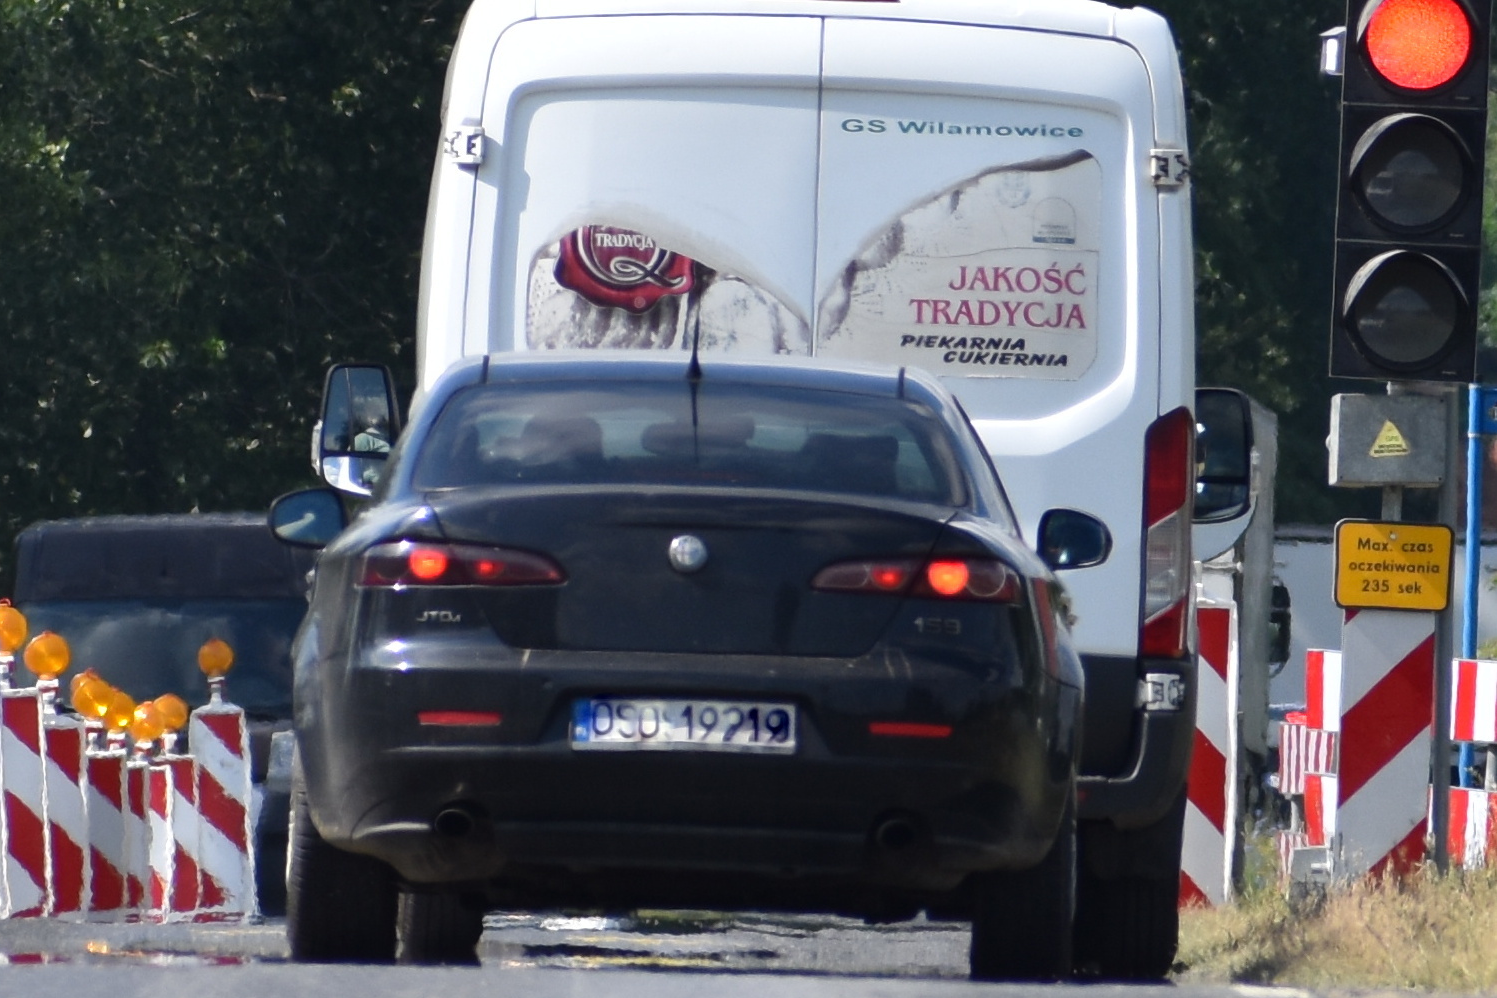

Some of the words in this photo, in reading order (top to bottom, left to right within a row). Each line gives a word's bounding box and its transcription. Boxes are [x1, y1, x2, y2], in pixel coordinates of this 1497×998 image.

[841, 118, 887, 134] GS
[897, 120, 1084, 138] Wilamowice
[595, 233, 654, 250] TRADYCJA
[949, 261, 1086, 295] JAKOŚĆ
[909, 298, 1087, 330] TRADYCJA
[900, 334, 1026, 351] PIEKARNIA
[943, 350, 1069, 367] CUKIERNIA
[1357, 537, 1393, 552] Max.
[1401, 541, 1434, 554] czas
[1348, 559, 1440, 574] oczekiwania
[1361, 579, 1390, 592] 235
[1398, 582, 1422, 595] sek
